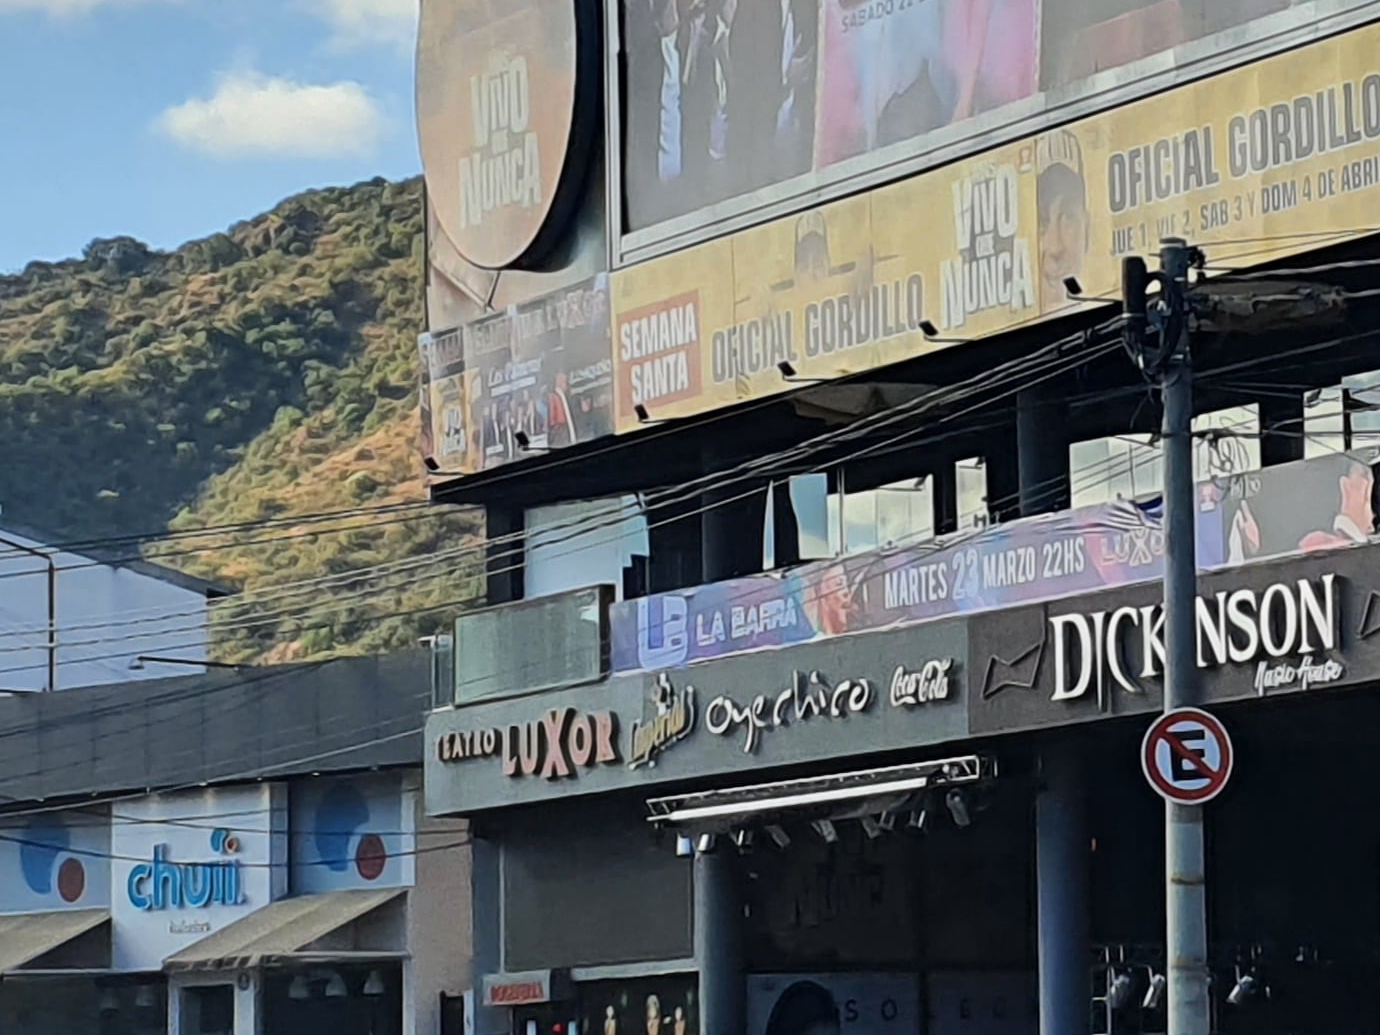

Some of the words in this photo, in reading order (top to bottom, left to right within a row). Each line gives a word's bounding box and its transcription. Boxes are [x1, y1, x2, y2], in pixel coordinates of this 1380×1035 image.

[470, 55, 529, 148] VIVO
[459, 131, 542, 230] NUNCA
[952, 164, 1019, 250] VIVO
[1107, 126, 1220, 214] OFICIAL
[1110, 225, 1134, 257] JUE
[1200, 198, 1229, 232] SAB
[1234, 194, 1244, 223] 3
[1247, 191, 1257, 218] Y
[1261, 178, 1298, 215] DOM
[1302, 173, 1313, 203] 4
[1318, 168, 1336, 200] DE
[940, 237, 1036, 331] NUNCA
[620, 302, 698, 362] SEMANA
[712, 309, 798, 384] OFICIAL
[804, 272, 923, 359] GORDILLO
[631, 350, 689, 405] SANTA
[884, 561, 948, 609] MARTES
[952, 545, 980, 600] 23
[982, 545, 1036, 590] MARZO
[1042, 536, 1086, 578] 22HS
[1099, 527, 1164, 569] LUXO
[696, 610, 726, 647] LA
[731, 596, 798, 640] BARRA
[1049, 572, 1336, 711] DICKNSON
[503, 707, 617, 778] LUXOR
[1167, 729, 1206, 782] E
